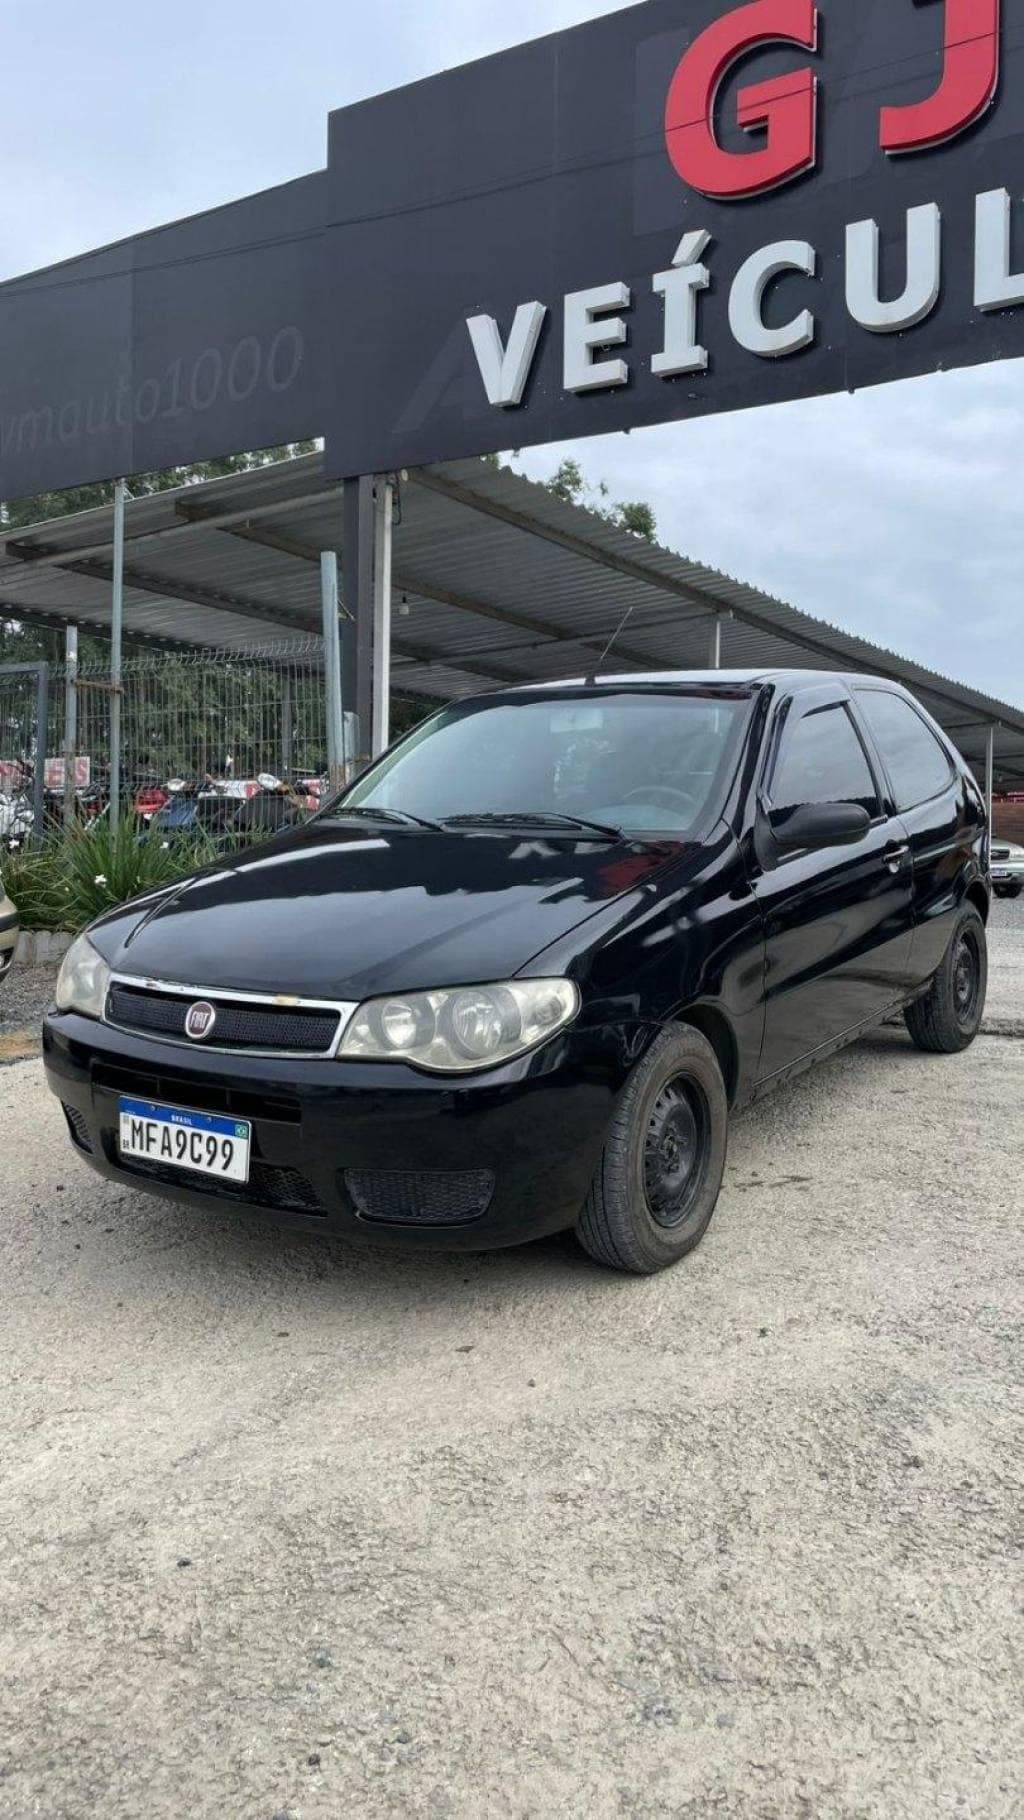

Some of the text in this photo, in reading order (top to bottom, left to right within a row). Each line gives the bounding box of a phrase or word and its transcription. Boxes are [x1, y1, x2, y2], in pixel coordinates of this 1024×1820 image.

[665, 0, 1002, 200] GJ
[466, 187, 1024, 407] VEÍCUL
[190, 1010, 210, 1029] FIAT
[131, 1119, 234, 1171] MFA9C99
[171, 1114, 193, 1126] BRASIL
